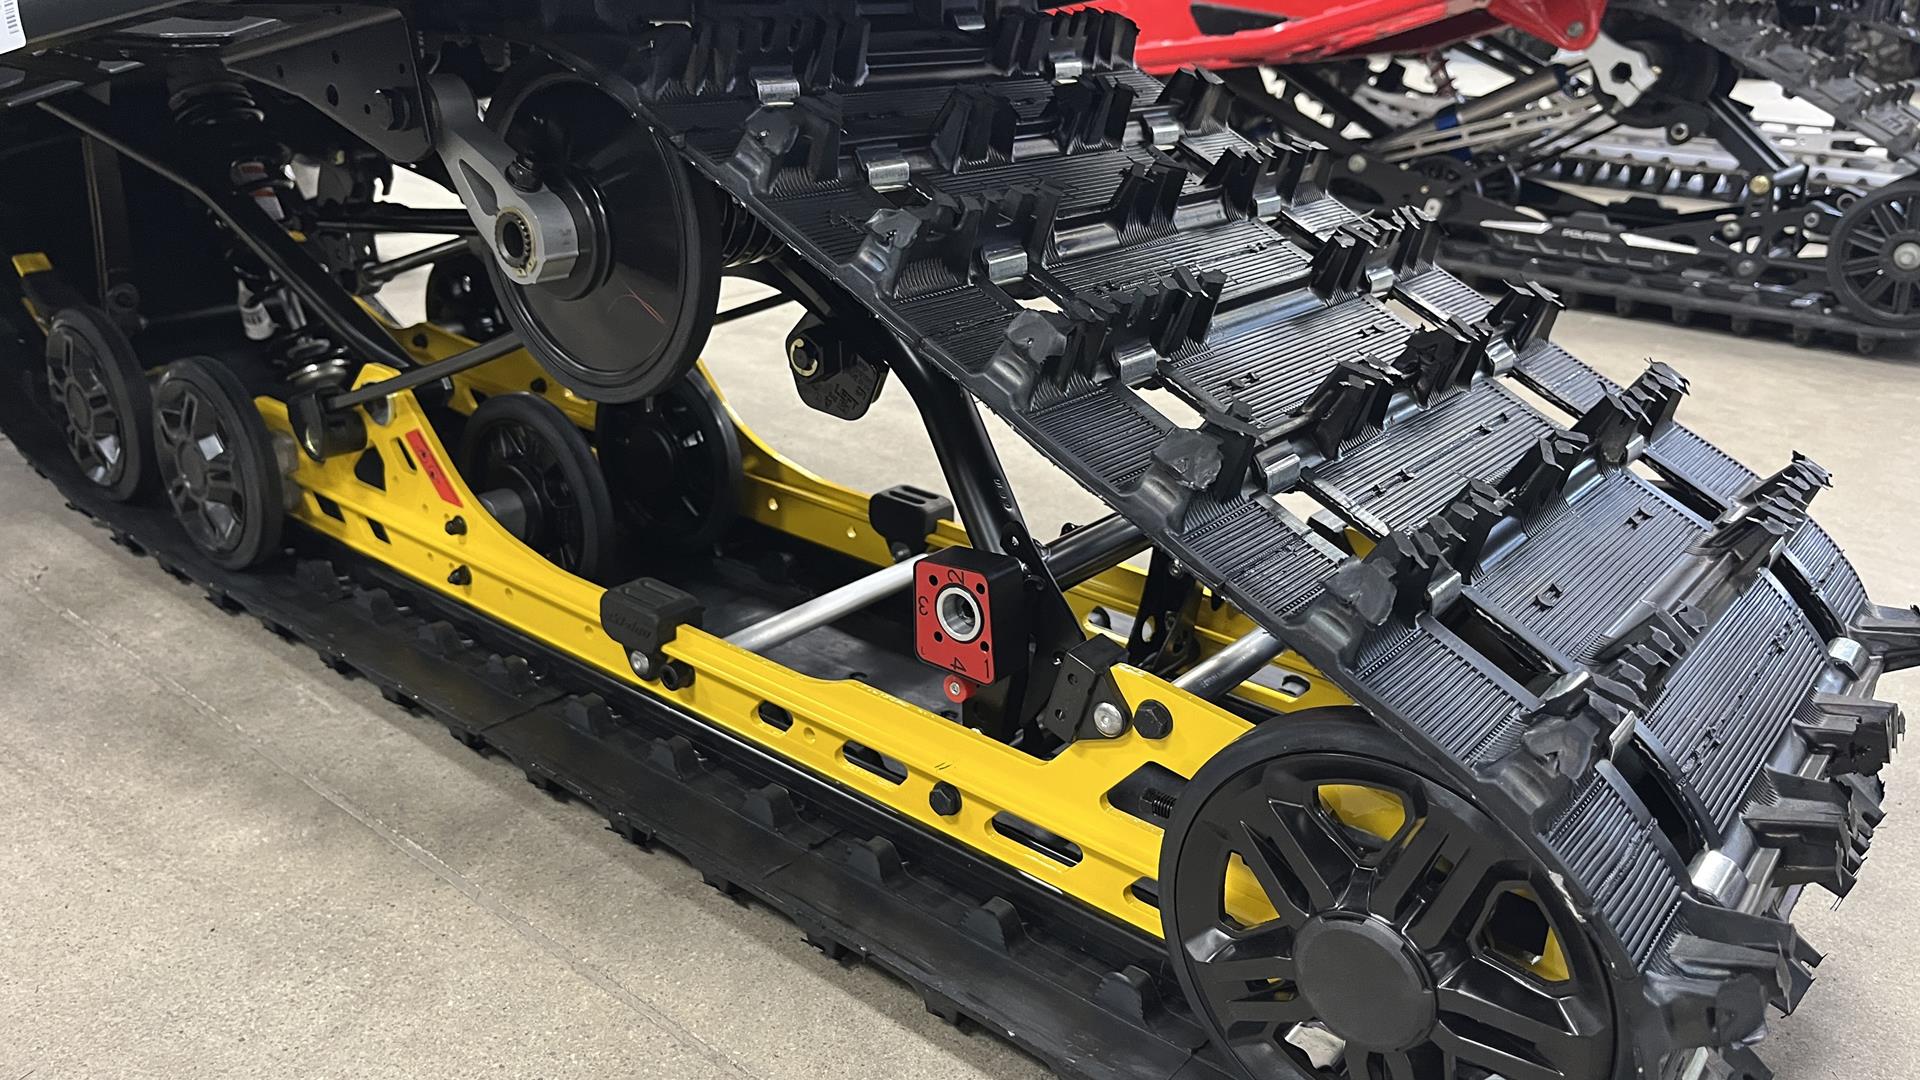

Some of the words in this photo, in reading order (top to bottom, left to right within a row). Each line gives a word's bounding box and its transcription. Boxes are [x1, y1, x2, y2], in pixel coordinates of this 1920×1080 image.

[947, 569, 965, 585] 2
[918, 595, 929, 616] 3
[949, 657, 967, 673] 4
